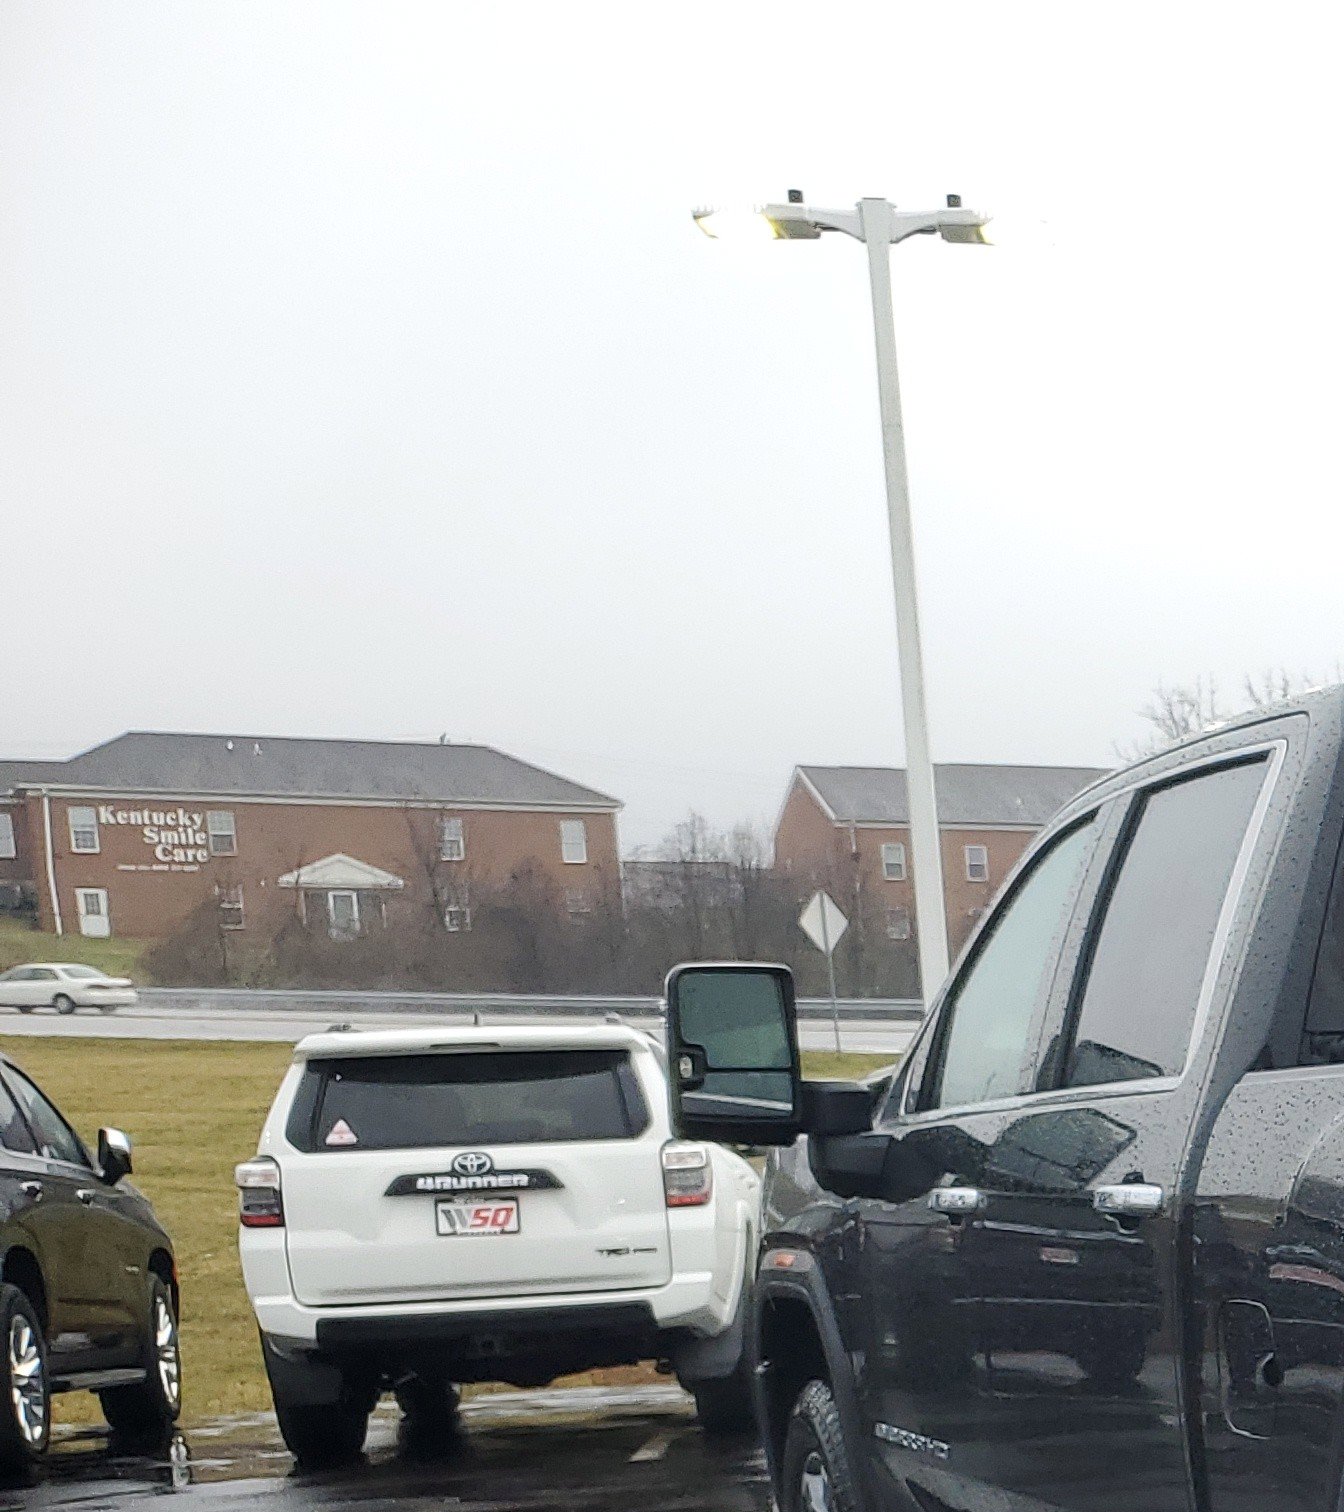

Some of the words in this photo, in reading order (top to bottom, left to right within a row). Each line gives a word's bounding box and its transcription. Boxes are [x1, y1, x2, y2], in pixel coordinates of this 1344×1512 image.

[98, 804, 204, 831] Kentucky
[142, 825, 207, 846] Smile
[154, 843, 209, 863] Care
[415, 1173, 530, 1190] 4RUNNER
